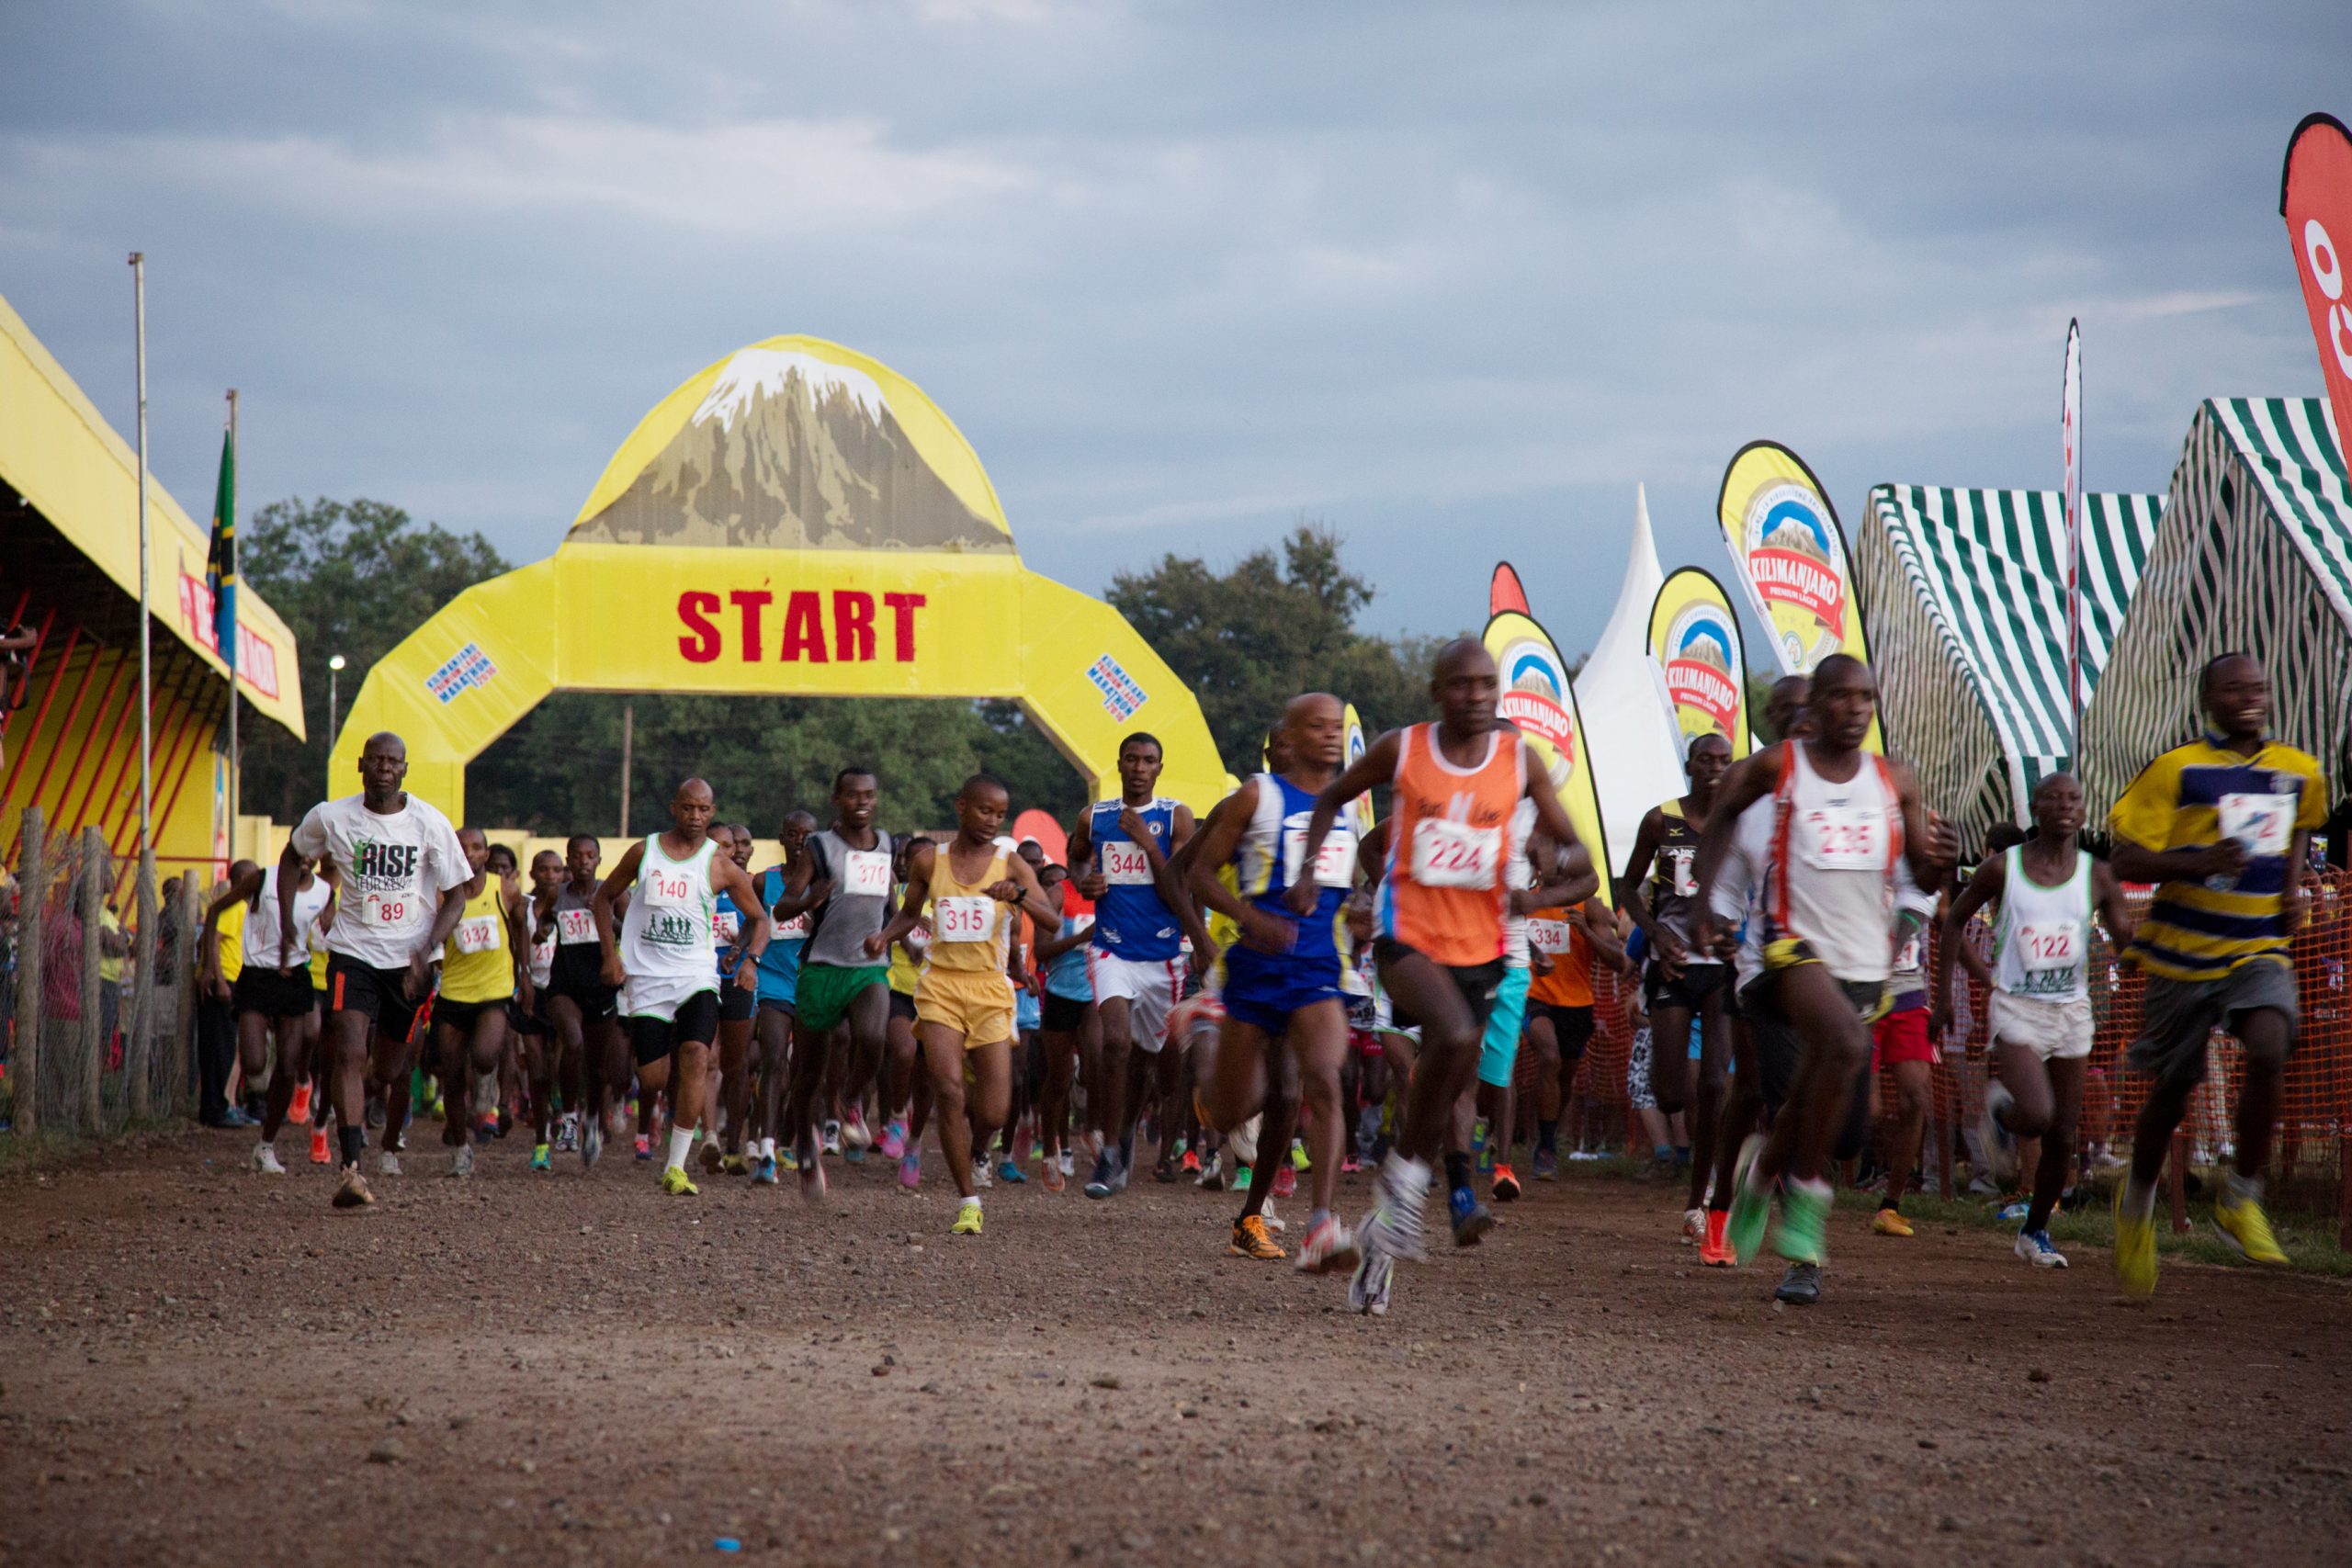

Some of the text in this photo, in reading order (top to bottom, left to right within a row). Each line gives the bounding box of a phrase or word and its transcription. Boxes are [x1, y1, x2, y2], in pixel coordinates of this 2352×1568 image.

[1750, 557, 1838, 606] KILIMANJARO
[1770, 586, 1818, 608] PREMIUM LAGER
[677, 589, 926, 663] START
[426, 643, 477, 688] KILIMANJARO
[438, 658, 491, 703] MARATHON
[1102, 654, 1148, 703] KILIMANJARO
[1087, 667, 1133, 716] MARATHON
[1668, 667, 1735, 712] KILIMANJARO
[1504, 696, 1569, 738] KILIMANJARO
[360, 843, 418, 877] RISE
[1111, 853, 1146, 874] 344
[1427, 839, 1482, 873] 224
[657, 879, 687, 898] 140
[381, 903, 403, 921] 89
[567, 919, 591, 935] 311
[945, 909, 984, 931] 315
[462, 925, 490, 945] 332
[1535, 928, 1561, 945] 334
[2030, 935, 2071, 959] 122
